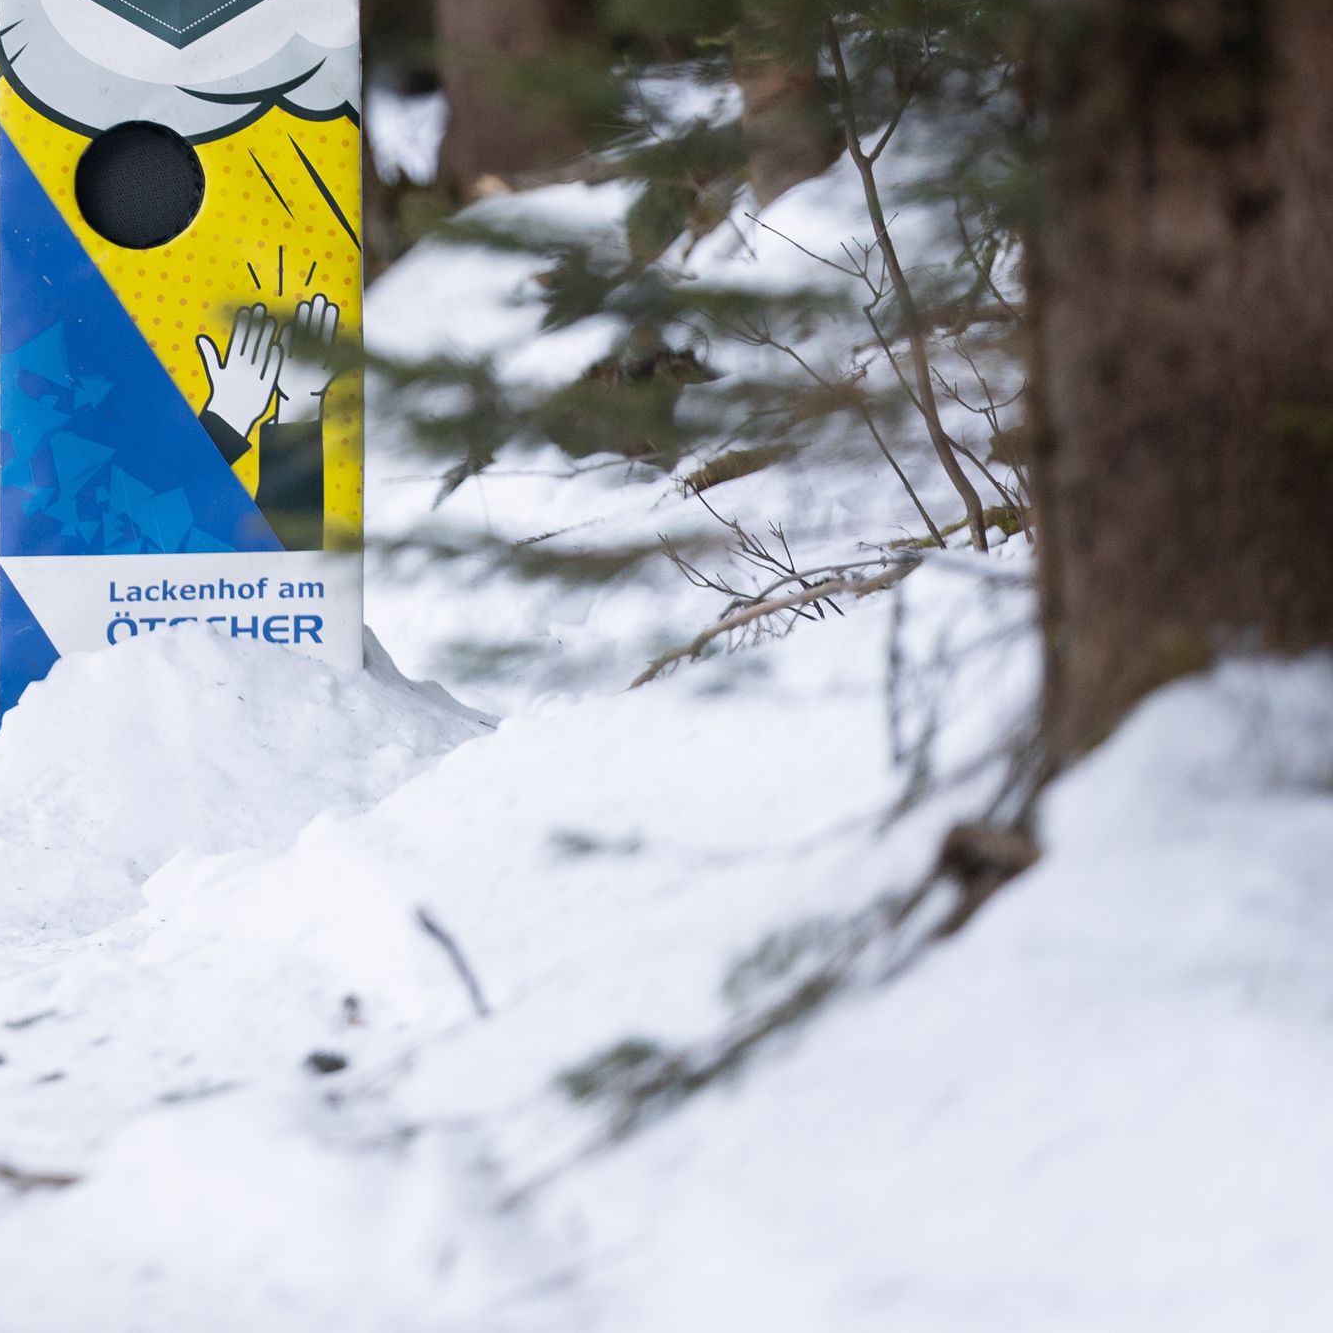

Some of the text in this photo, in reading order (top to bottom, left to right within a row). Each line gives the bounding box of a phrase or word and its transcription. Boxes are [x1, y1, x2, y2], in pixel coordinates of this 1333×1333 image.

[109, 577, 325, 603] Lackenhof am
[106, 612, 324, 646] ÖTHER
